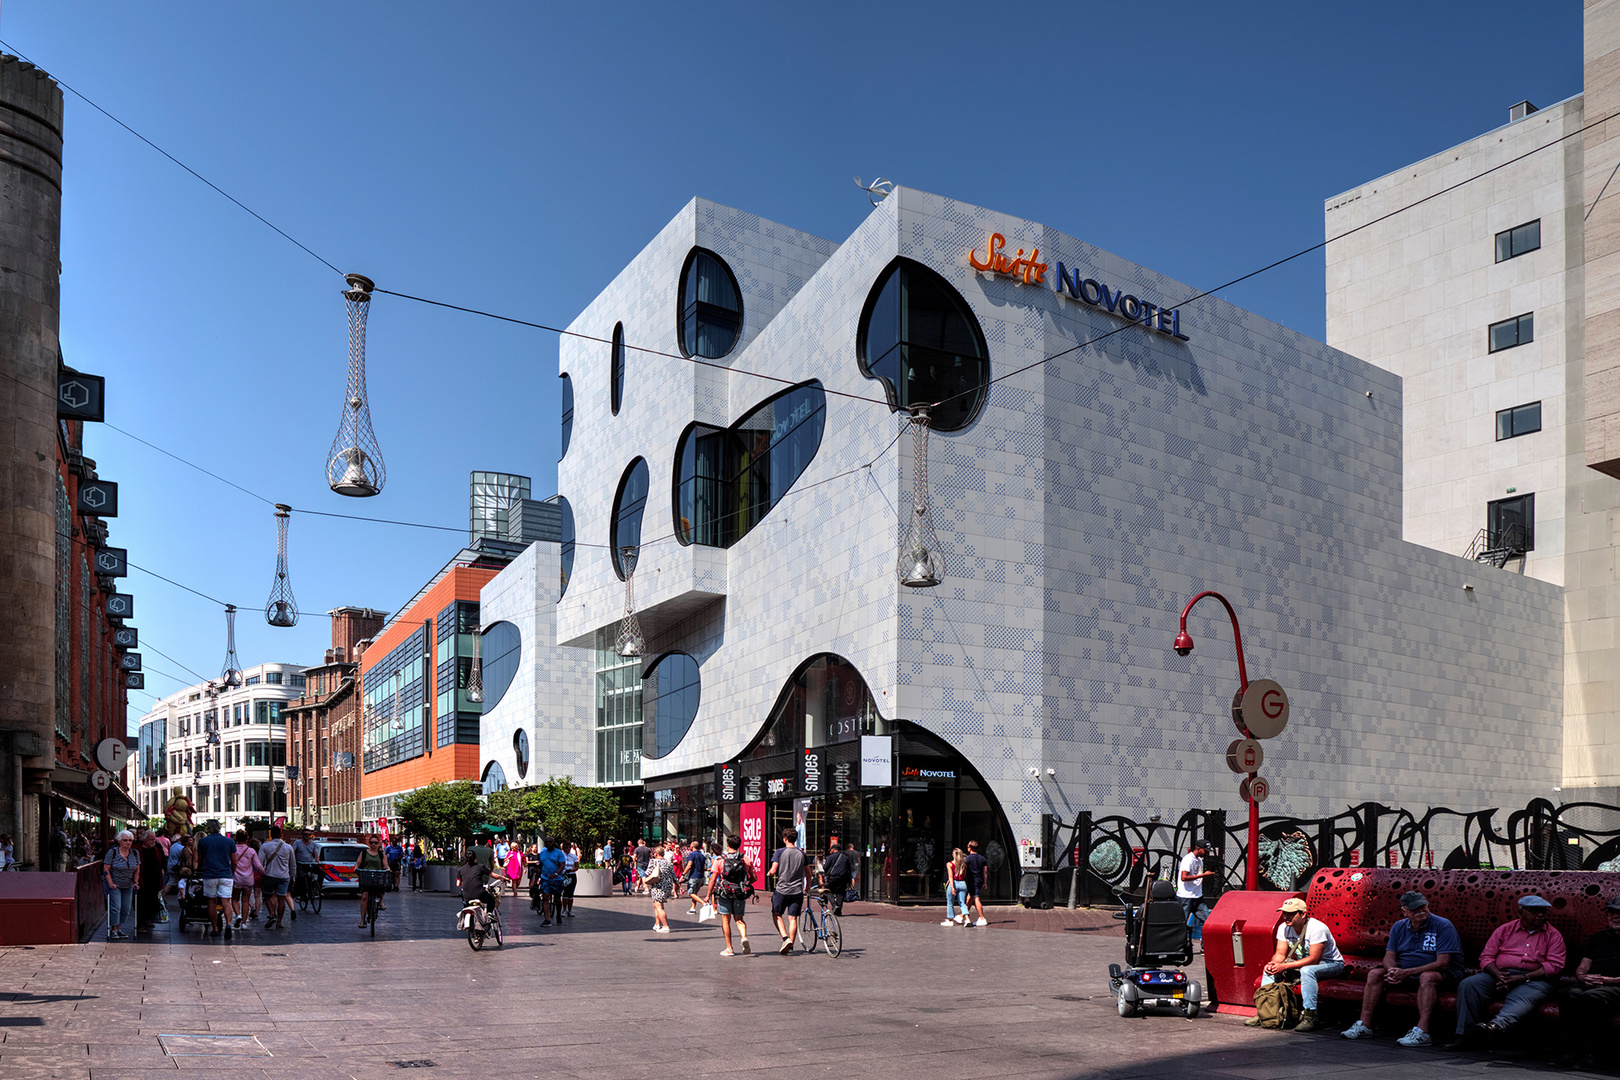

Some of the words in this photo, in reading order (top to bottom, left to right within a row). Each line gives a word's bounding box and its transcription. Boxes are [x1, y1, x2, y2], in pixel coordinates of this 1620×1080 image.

[968, 232, 1048, 285] Suite
[1055, 261, 1190, 342] NOVOTEL
[1261, 689, 1284, 719] G
[112, 743, 121, 761] F
[805, 753, 821, 792] snipes
[902, 766, 919, 777] Suite
[919, 769, 957, 778] NOVOTEL
[722, 768, 736, 800] snipes
[768, 778, 784, 795] snipes
[1256, 786, 1264, 797] P
[743, 817, 762, 841] sale
[1423, 935, 1437, 947] 29
